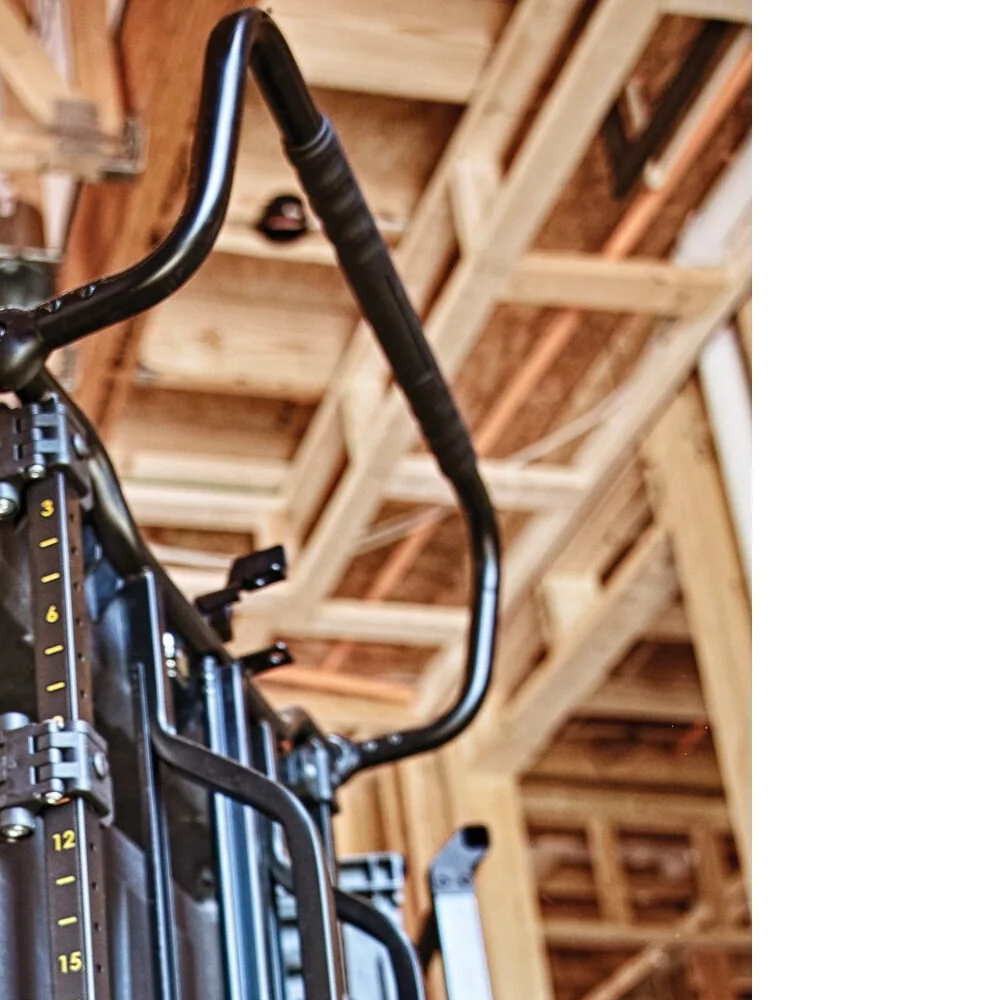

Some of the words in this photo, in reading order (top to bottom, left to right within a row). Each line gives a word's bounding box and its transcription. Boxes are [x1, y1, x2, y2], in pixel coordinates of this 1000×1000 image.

[40, 499, 55, 518] 3
[45, 605, 60, 624] 6
[52, 829, 76, 851] 12
[58, 951, 83, 973] 15
